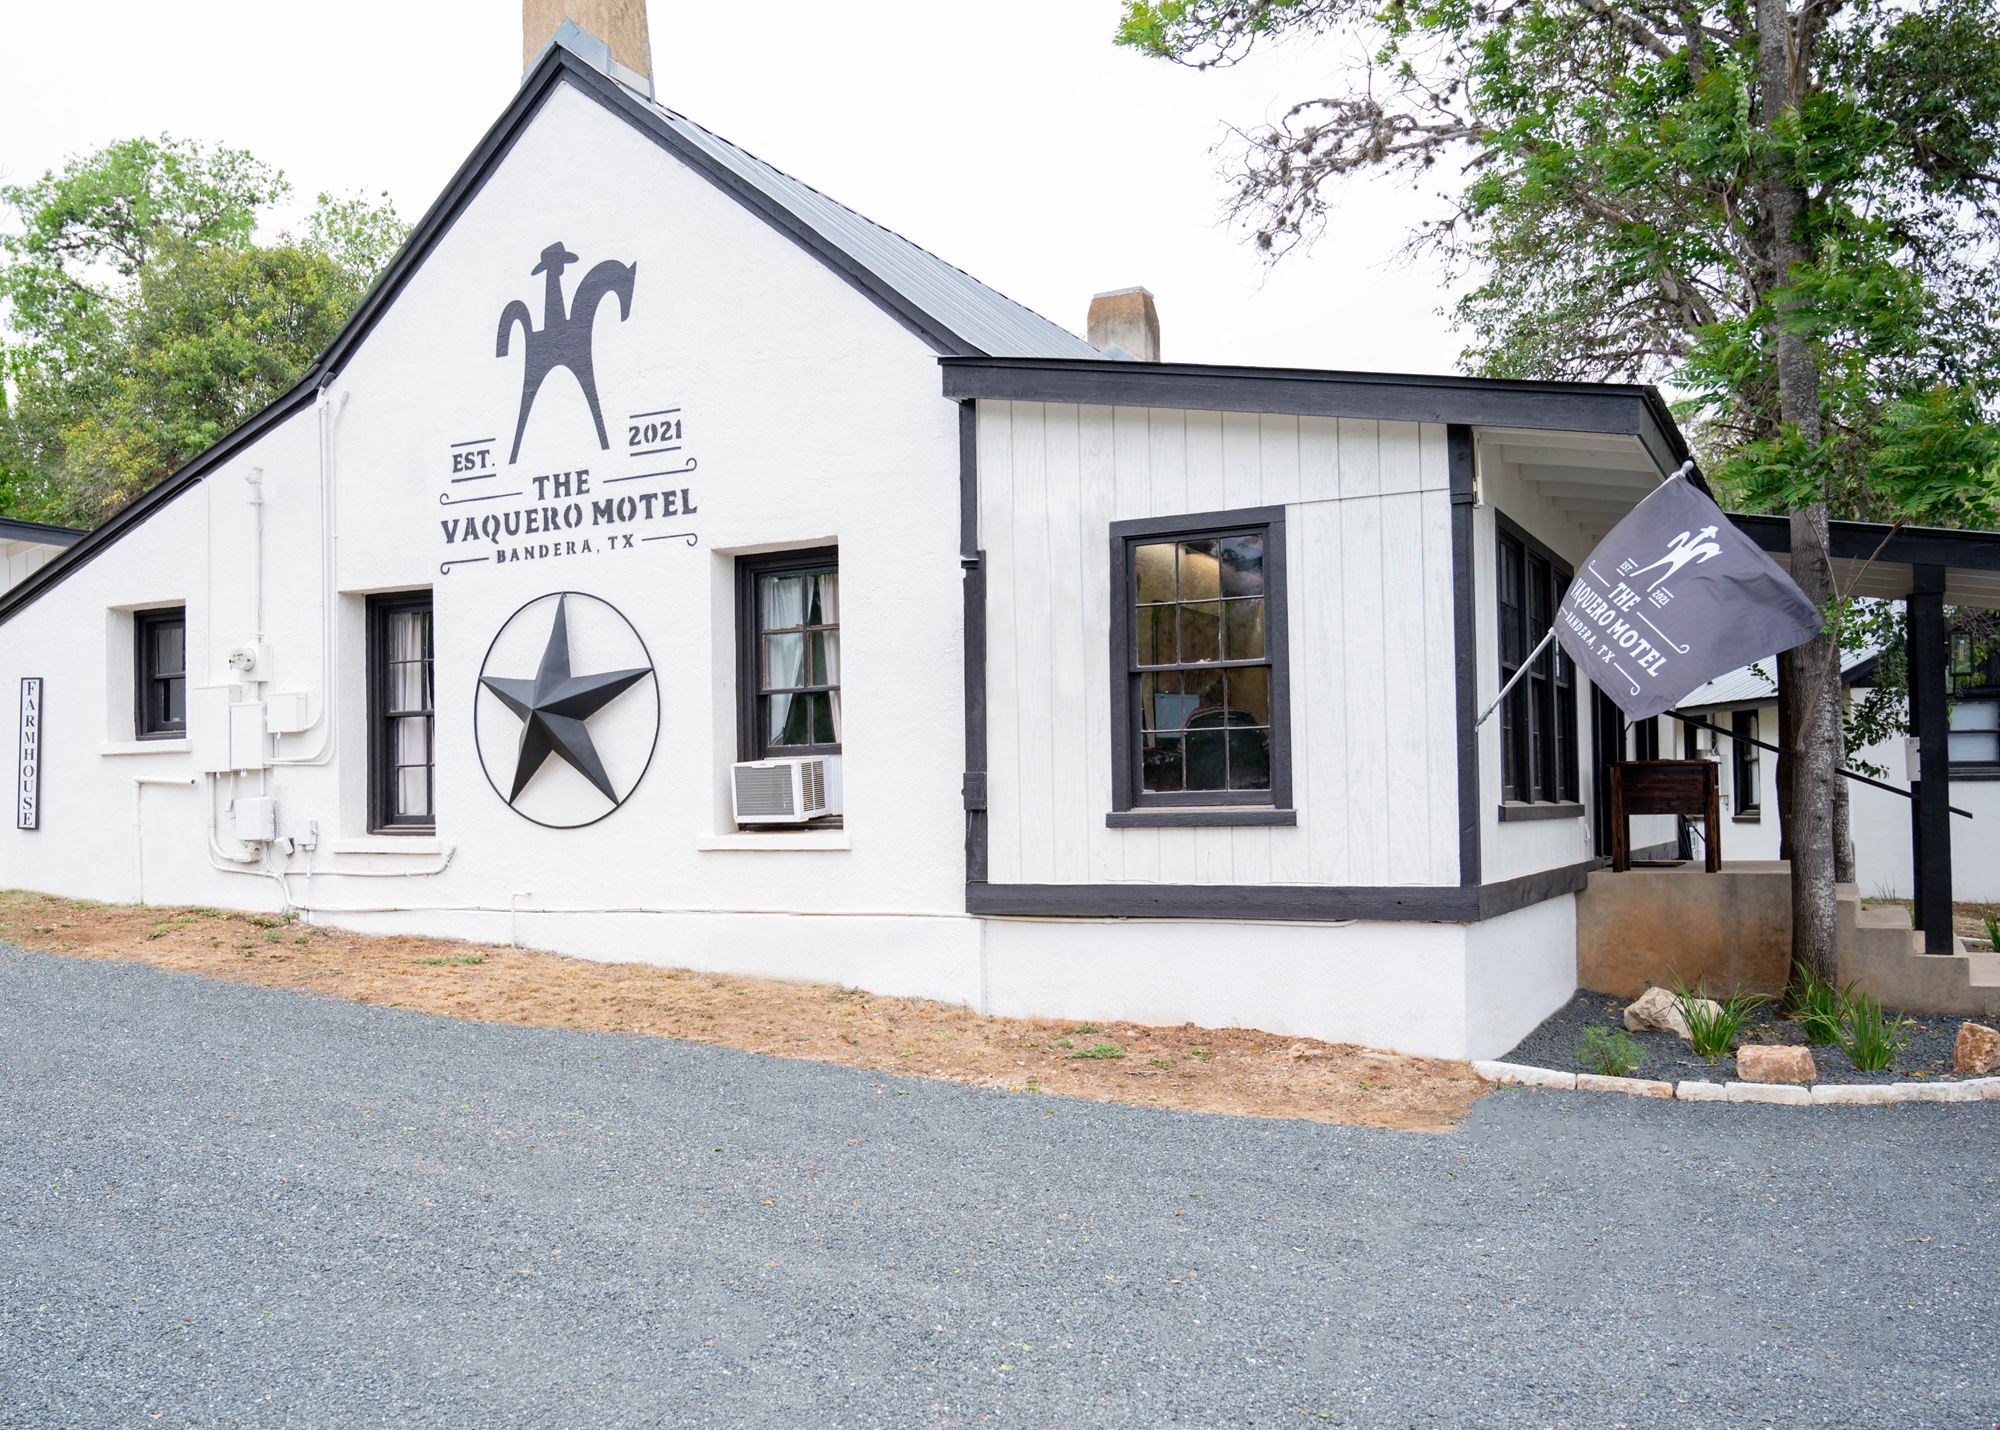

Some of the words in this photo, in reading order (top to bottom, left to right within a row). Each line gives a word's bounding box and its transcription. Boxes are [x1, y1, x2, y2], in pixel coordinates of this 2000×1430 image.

[628, 419, 682, 446] 2021
[452, 449, 496, 474] EST.
[532, 469, 591, 501] THE
[440, 503, 583, 544] VAQUERO
[592, 488, 698, 526] MOTEL
[497, 539, 600, 564] BANDERA,
[608, 534, 634, 549] TX
[1619, 561, 1633, 574] EST.
[1608, 582, 1641, 613] THE
[1651, 589, 1671, 606] 2021
[1565, 611, 1597, 650] BANDERA,
[1597, 644, 1615, 664] TX
[1570, 577, 1617, 626] VAQUERO
[1606, 618, 1667, 677] MOTEL
[22, 681, 37, 826] FARMHOUSE
